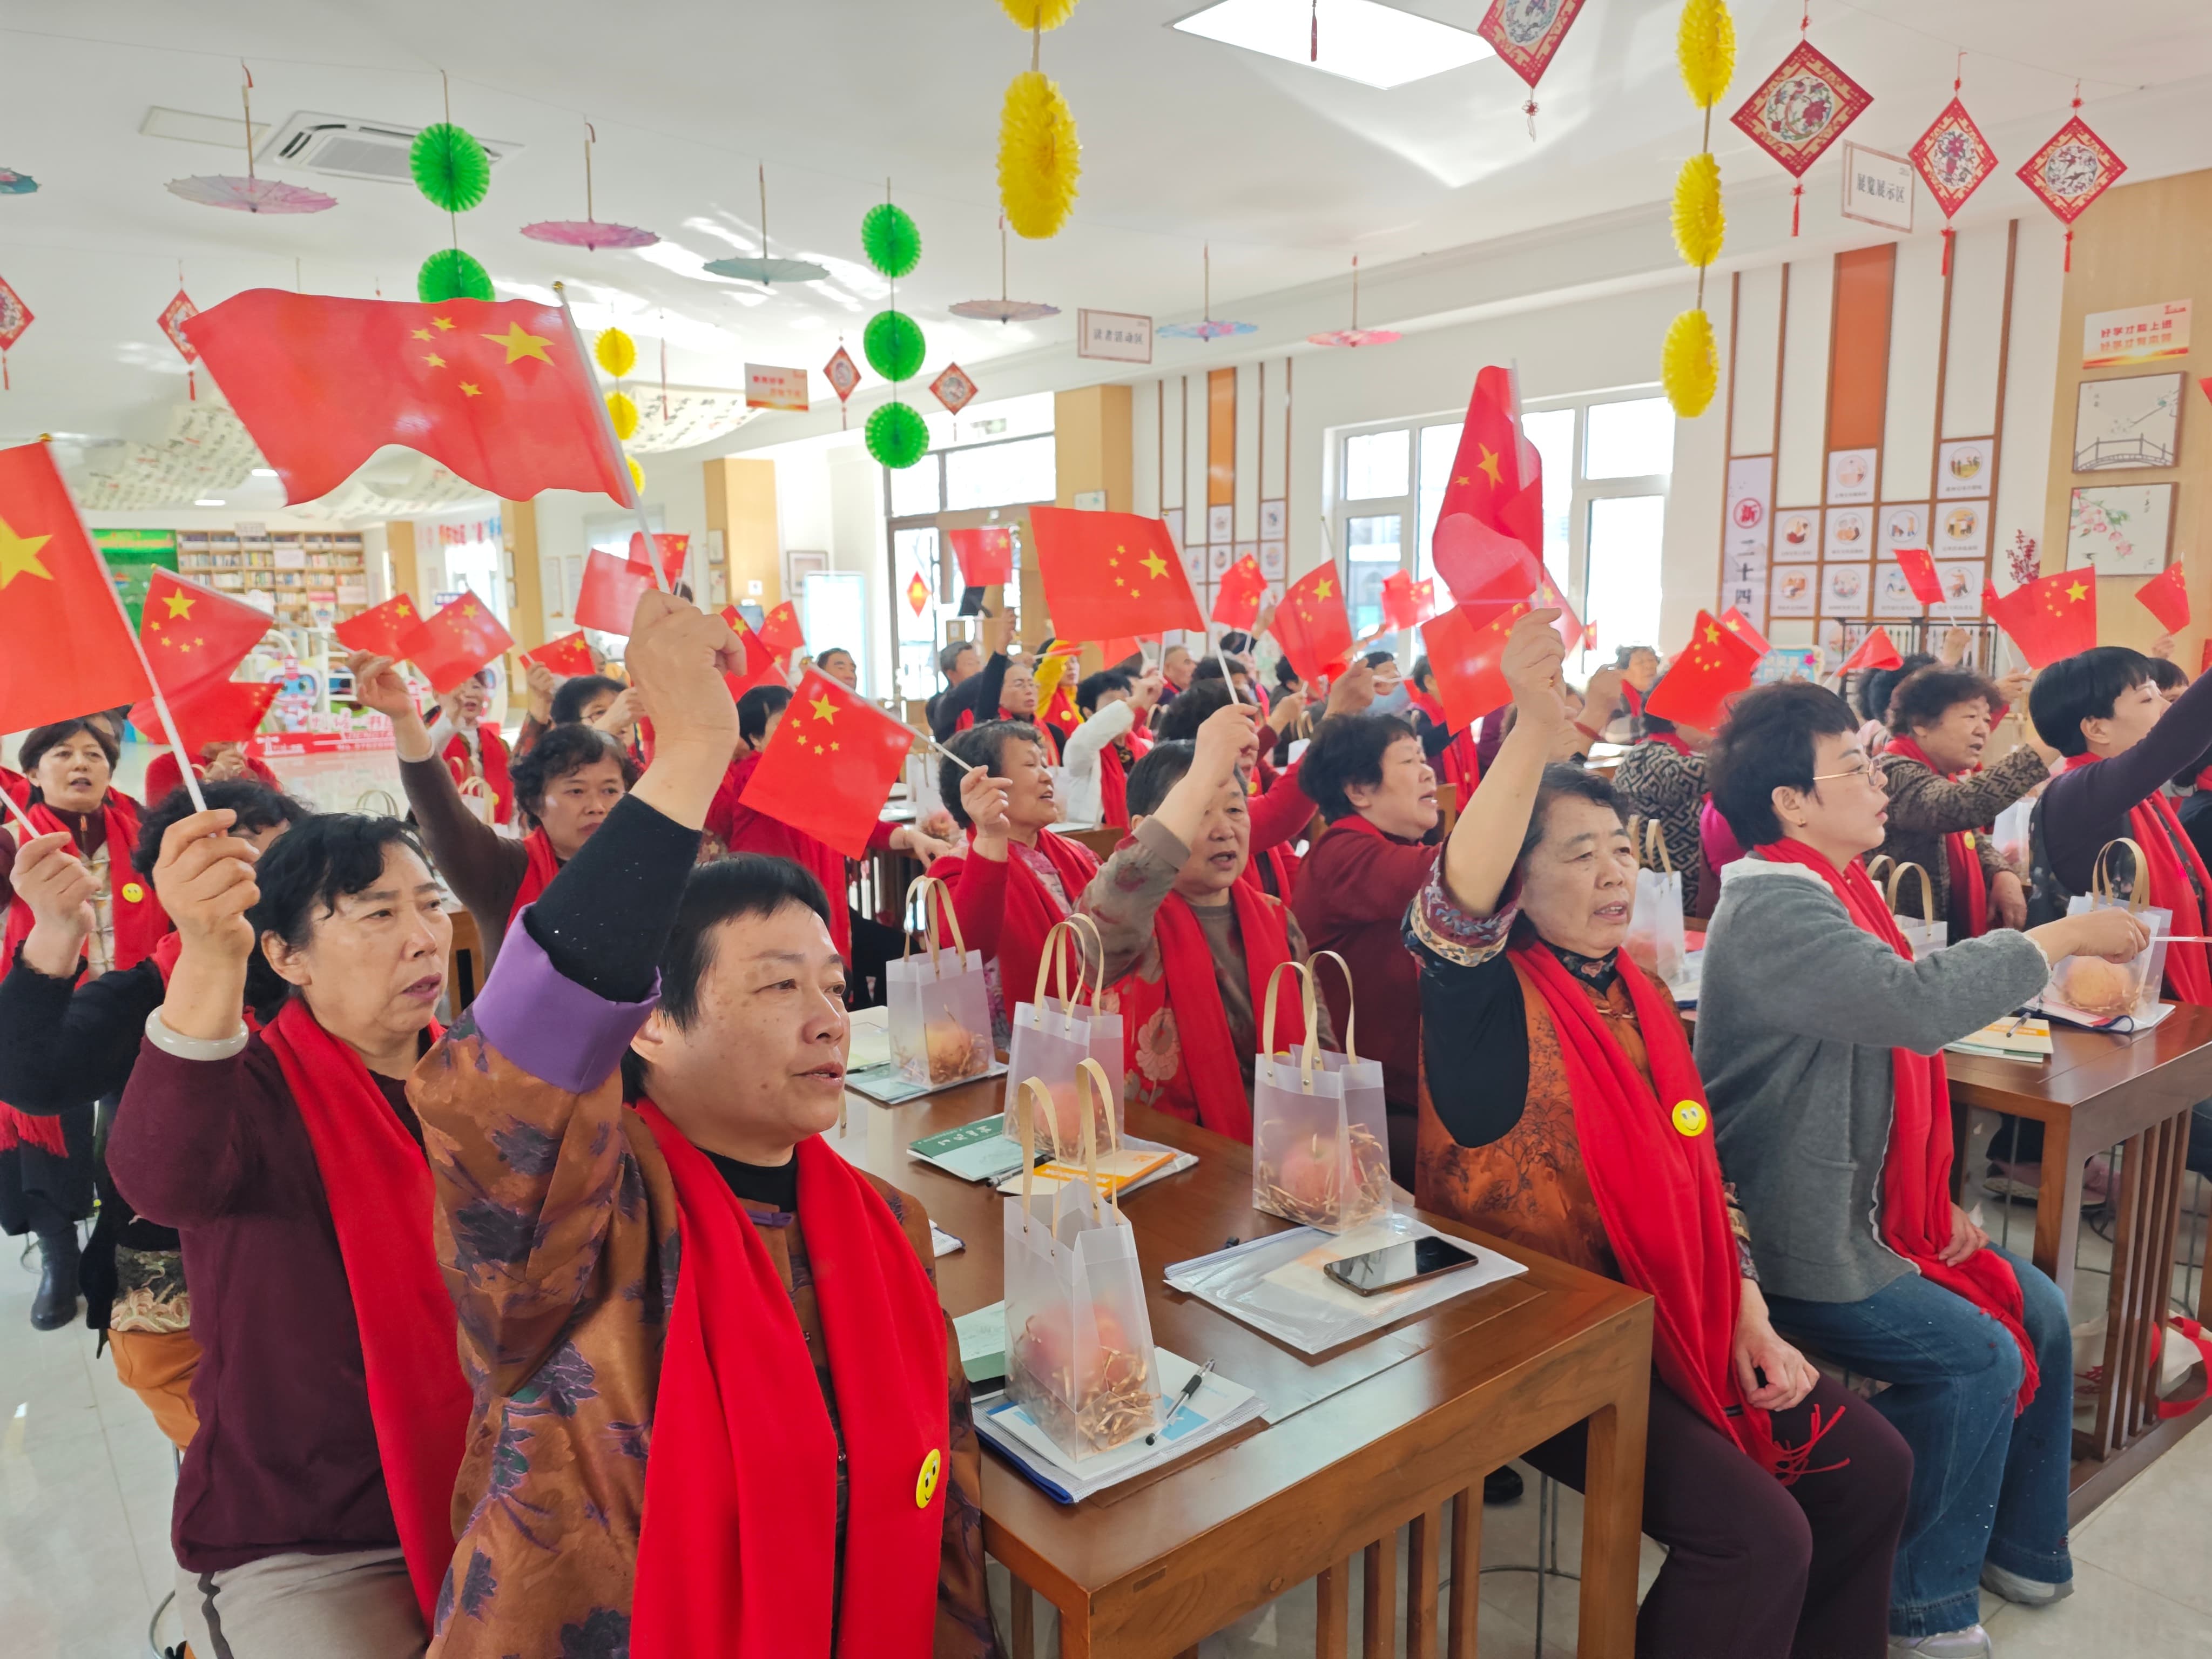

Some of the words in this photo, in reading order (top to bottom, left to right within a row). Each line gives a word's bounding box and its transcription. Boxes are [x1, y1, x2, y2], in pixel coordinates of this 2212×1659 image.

[1857, 172, 1905, 204] 展览展示区
